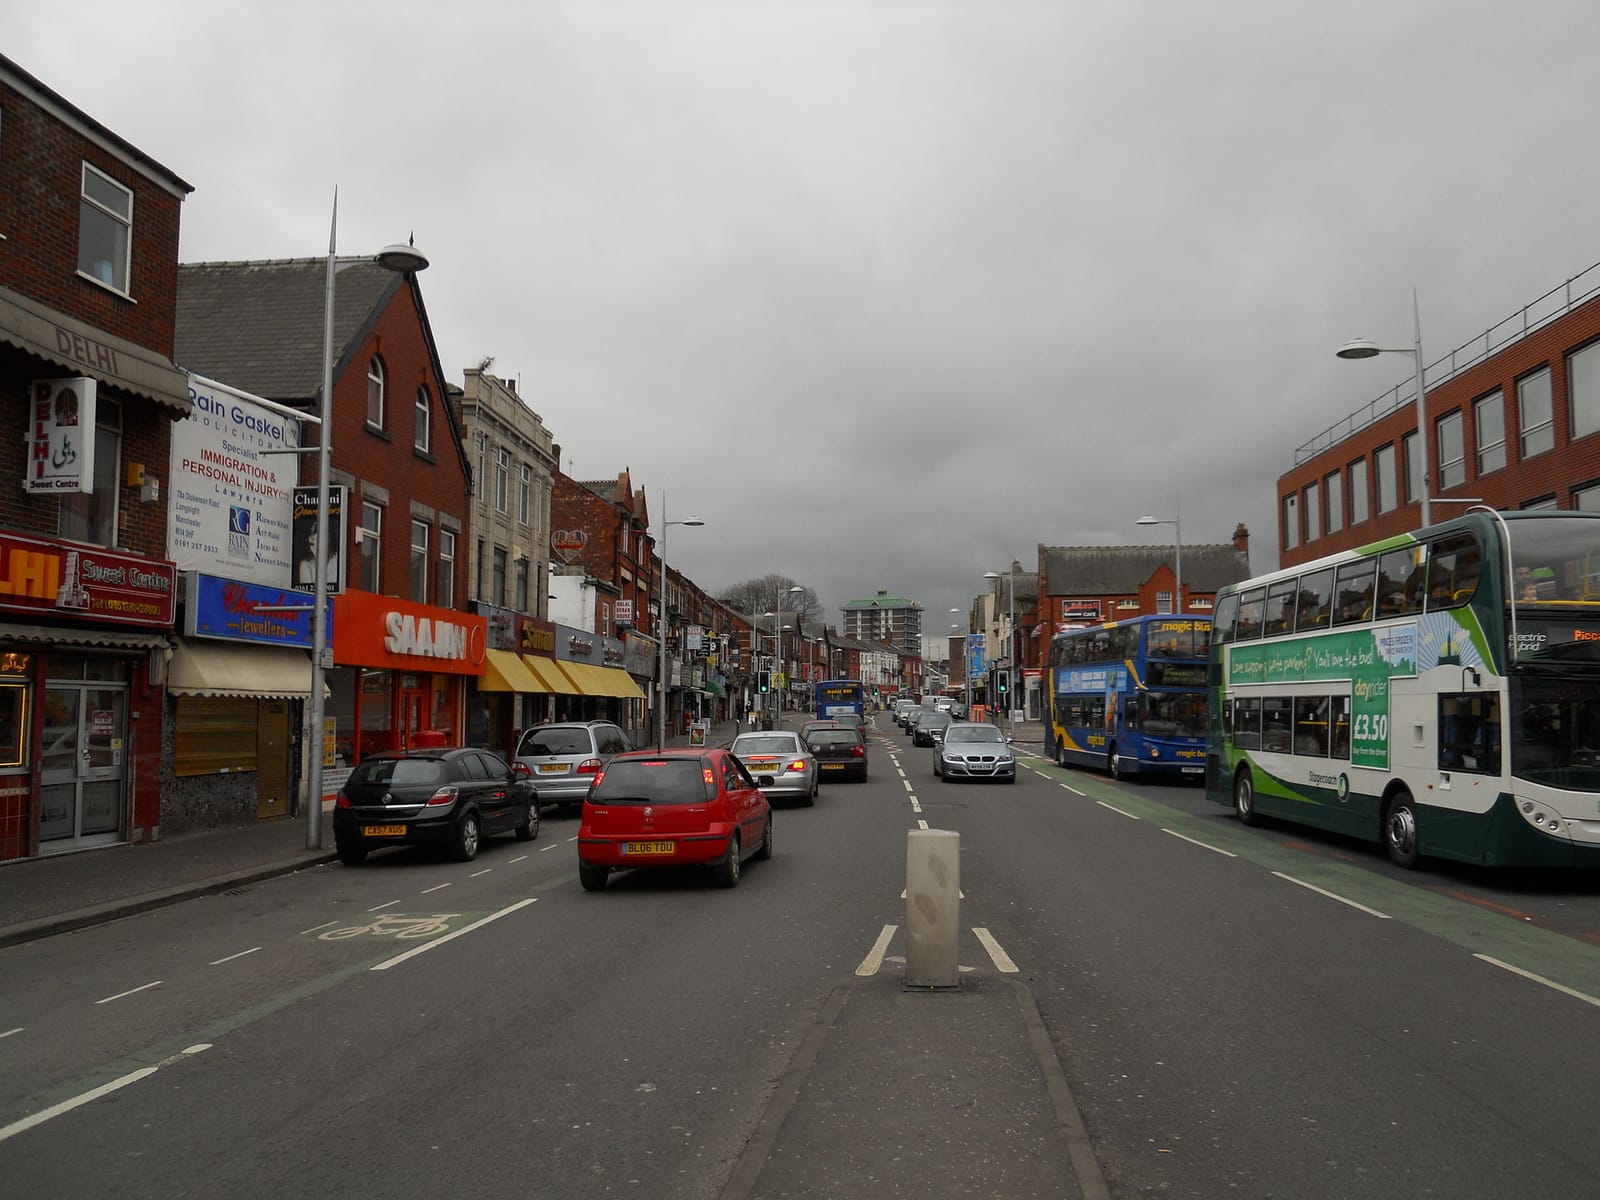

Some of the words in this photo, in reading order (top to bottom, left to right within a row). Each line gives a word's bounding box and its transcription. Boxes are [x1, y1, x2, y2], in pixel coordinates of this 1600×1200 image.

[57, 328, 118, 374] DELHI
[188, 387, 225, 417] Rain
[34, 384, 52, 480] DELHI
[193, 413, 284, 449] SOLICITOR
[222, 439, 258, 461] Specialist
[201, 448, 268, 481] IMMIGRATION
[270, 473, 276, 483] &
[31, 480, 53, 488] Sweet
[56, 480, 79, 488] Centre
[182, 459, 242, 487] PERSONAL
[244, 480, 279, 499] INJURY
[215, 484, 262, 505] Lawyers
[295, 493, 340, 505] Chani
[176, 514, 201, 527] Manchester
[175, 539, 189, 547] 0161
[82, 559, 126, 585] Sweet
[129, 567, 170, 592] Centre
[240, 617, 287, 637] Jewellers
[384, 611, 467, 661] SAAJAN
[1162, 621, 1192, 633] magic
[1194, 621, 1212, 632] bus
[1574, 630, 1600, 640] Picc
[1509, 633, 1546, 642] eectric
[1354, 714, 1387, 740] £3.50
[1176, 750, 1196, 758] magic
[1309, 770, 1337, 786] Stagecoach
[628, 843, 652, 853] BL06
[655, 843, 672, 852] TDU
